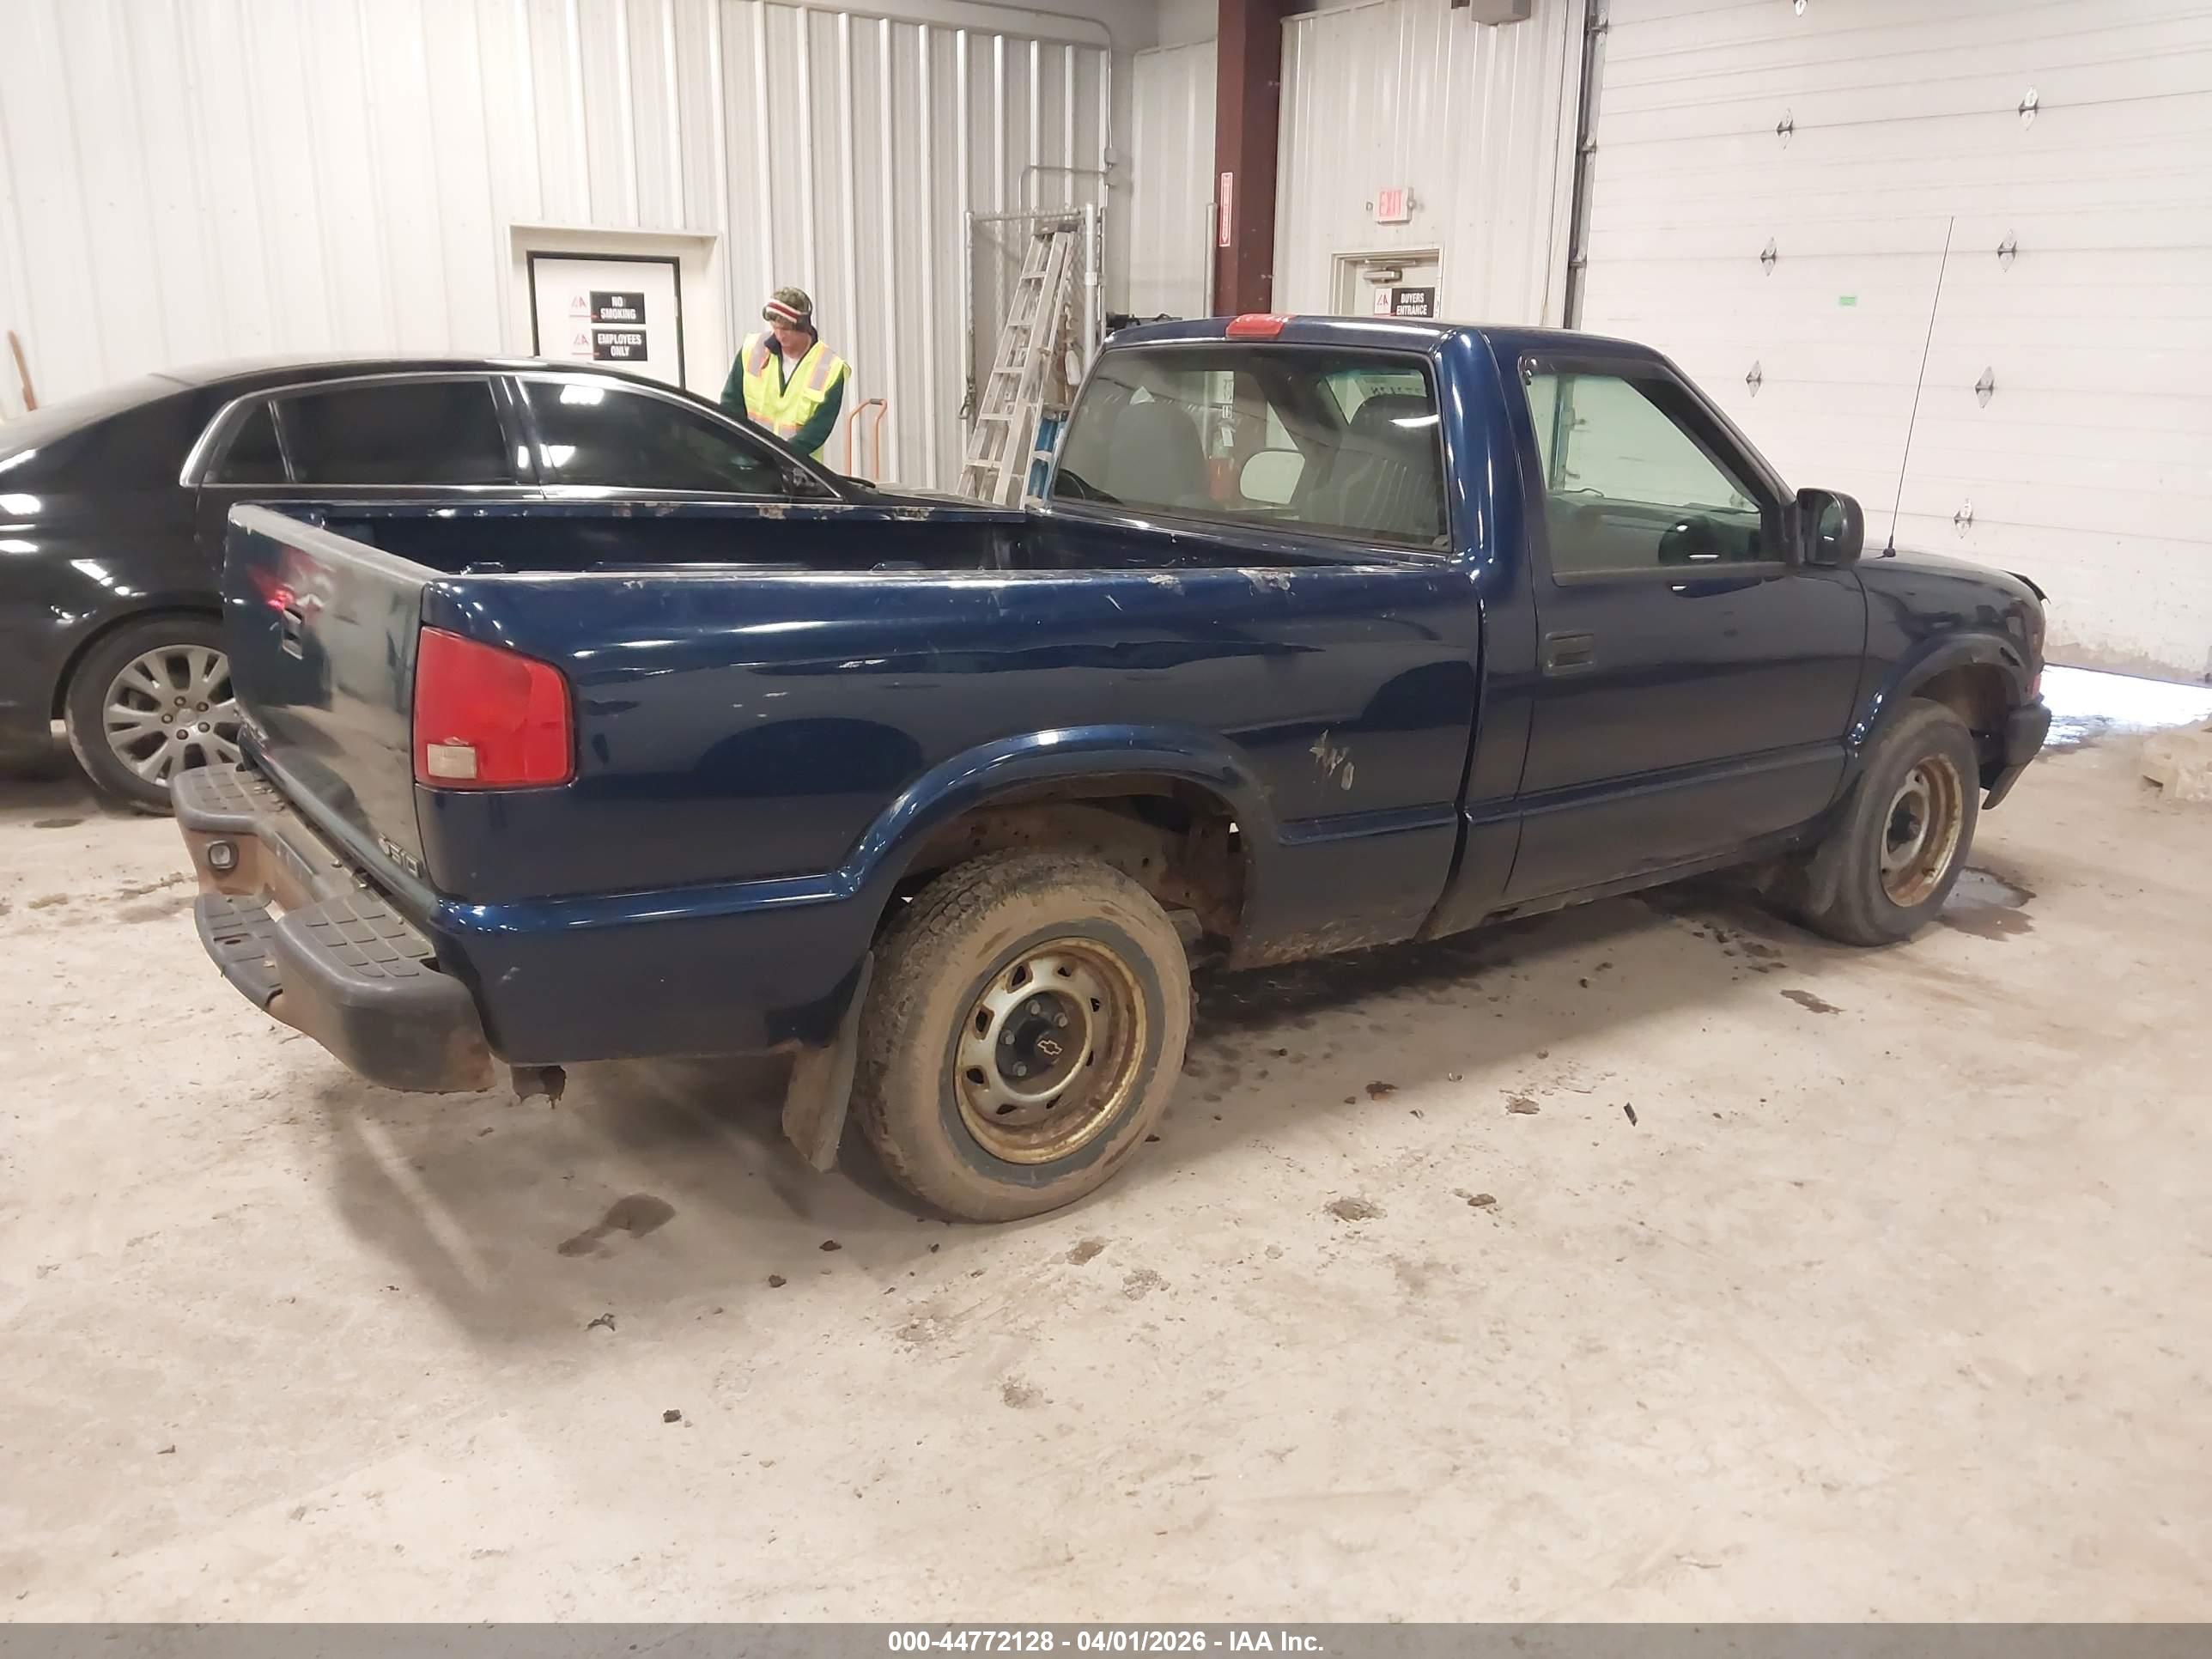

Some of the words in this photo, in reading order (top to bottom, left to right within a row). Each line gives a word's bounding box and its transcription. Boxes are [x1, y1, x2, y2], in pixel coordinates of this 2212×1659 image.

[1379, 190, 1402, 216] EXIT
[611, 296, 623, 307] NO
[1401, 293, 1425, 304] BUYERS
[600, 307, 636, 319] SMOKING
[1396, 305, 1427, 316] ENTRANCE
[598, 333, 641, 345] EMPLOYEES
[611, 345, 630, 356] ONLY
